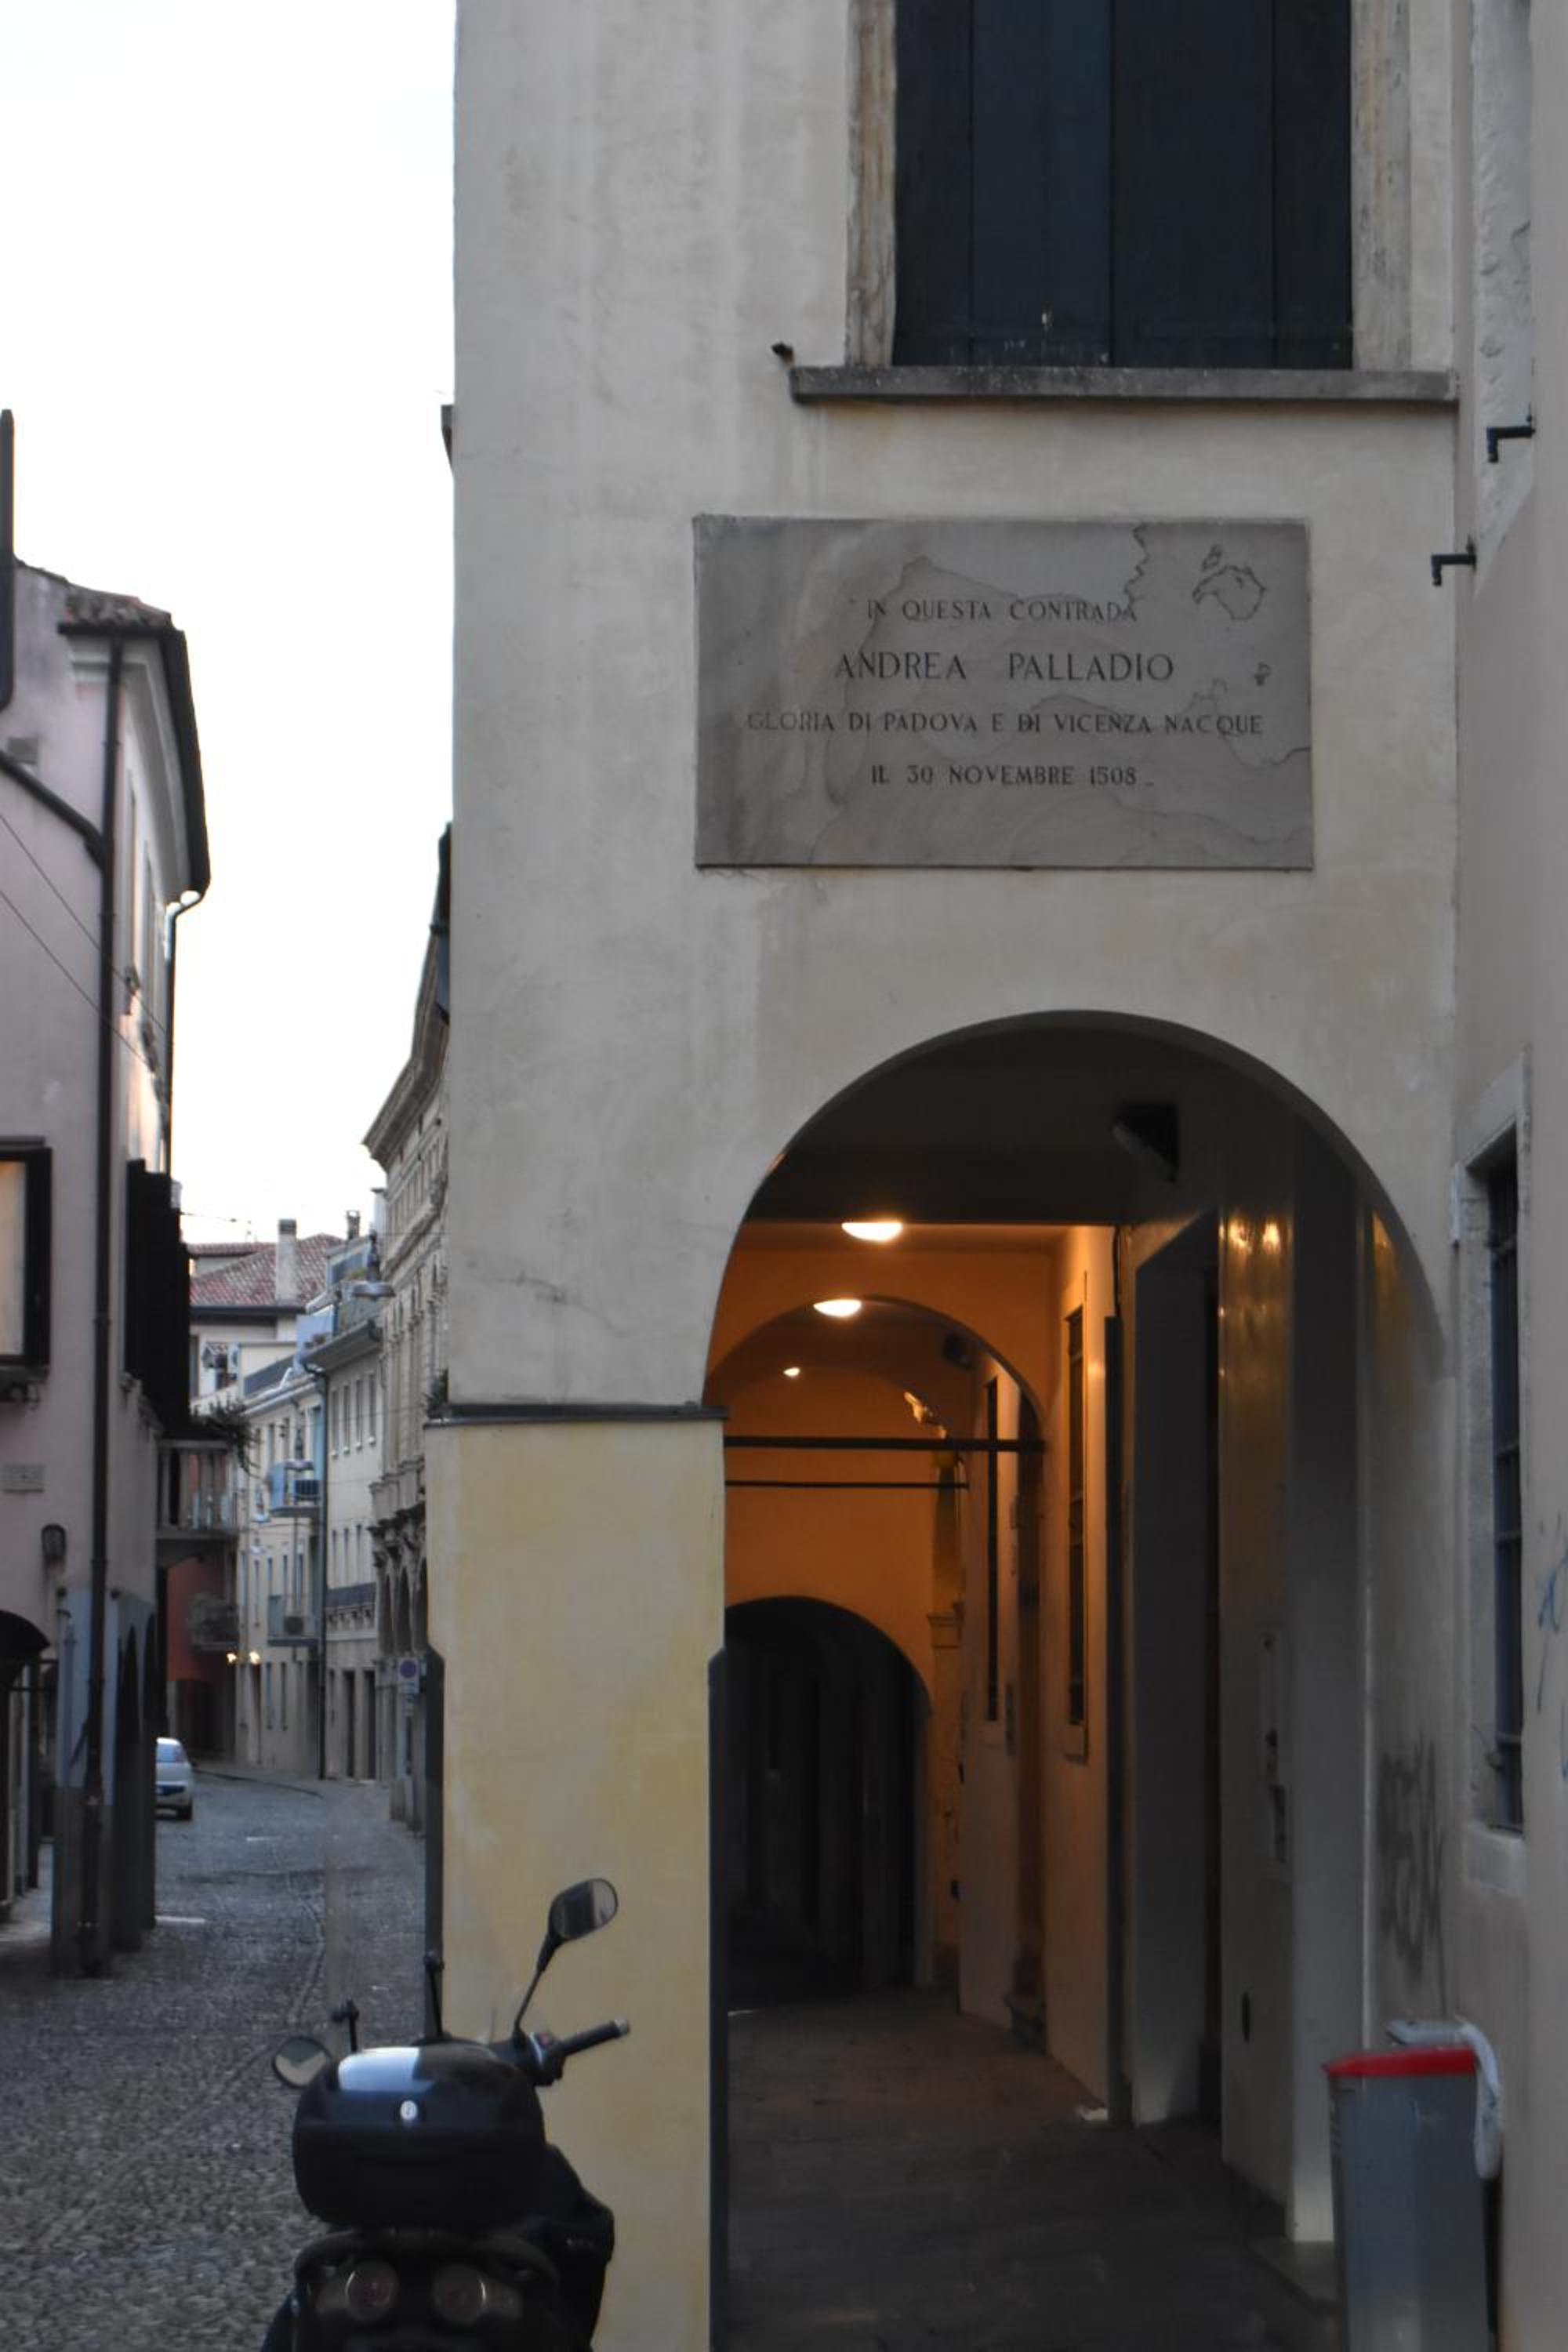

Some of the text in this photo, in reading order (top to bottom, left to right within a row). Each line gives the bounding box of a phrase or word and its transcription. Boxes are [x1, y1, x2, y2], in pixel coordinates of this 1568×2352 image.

[867, 599, 1137, 621] IN QUESTA CONTRADA
[835, 652, 1174, 681] ANDREA PALLADIO
[747, 711, 1263, 737] GLORIA DI PADOVA E DI VICENZA NACQUE
[872, 765, 1137, 785] IL 30 NOVEMBRE 1508
